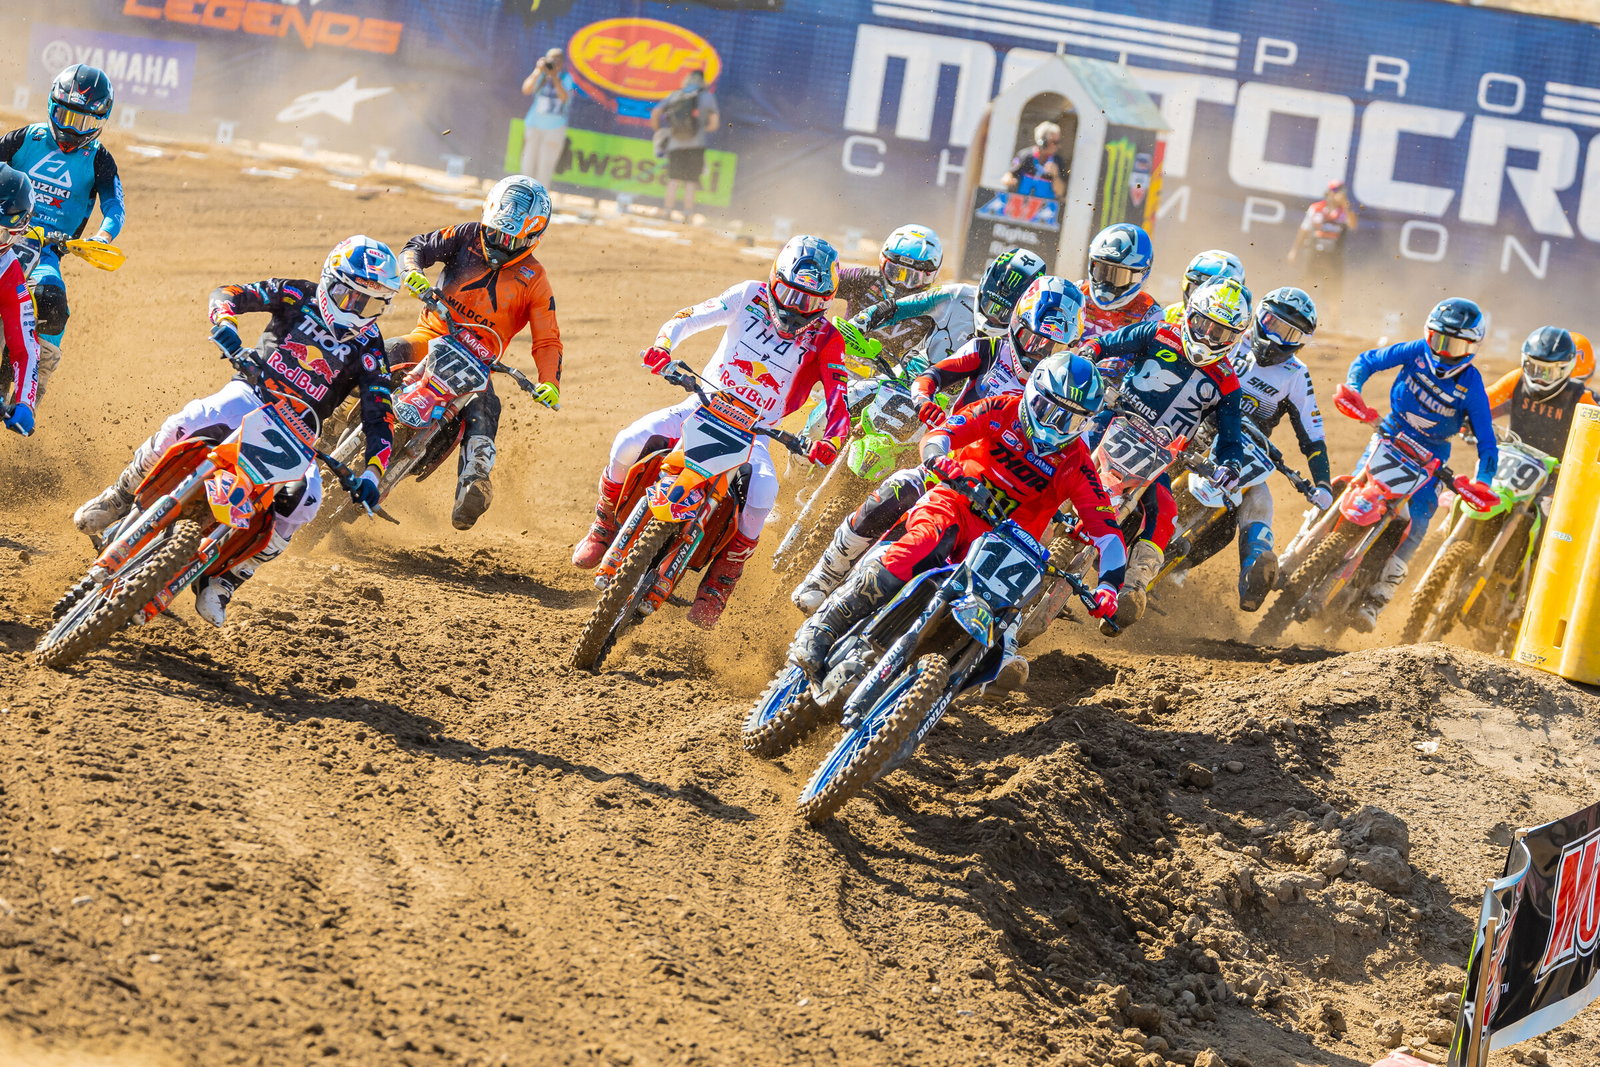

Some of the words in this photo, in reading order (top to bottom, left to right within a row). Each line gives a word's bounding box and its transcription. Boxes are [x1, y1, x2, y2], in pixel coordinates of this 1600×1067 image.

[585, 35, 704, 74] FMF
[843, 24, 1600, 244] MTOCR
[448, 296, 496, 328] WILDCAT
[297, 314, 352, 363] THOR
[1246, 376, 1280, 397] SHOT
[1418, 389, 1456, 418] RACING
[1521, 397, 1563, 421] SEVEN
[240, 428, 302, 481] 2
[684, 423, 748, 464] 7
[1368, 452, 1418, 488] 77
[177, 549, 216, 588] DUNLP
[671, 528, 700, 573] DUNLP
[976, 541, 1039, 604] 14
[917, 690, 953, 742] DUNLOP
